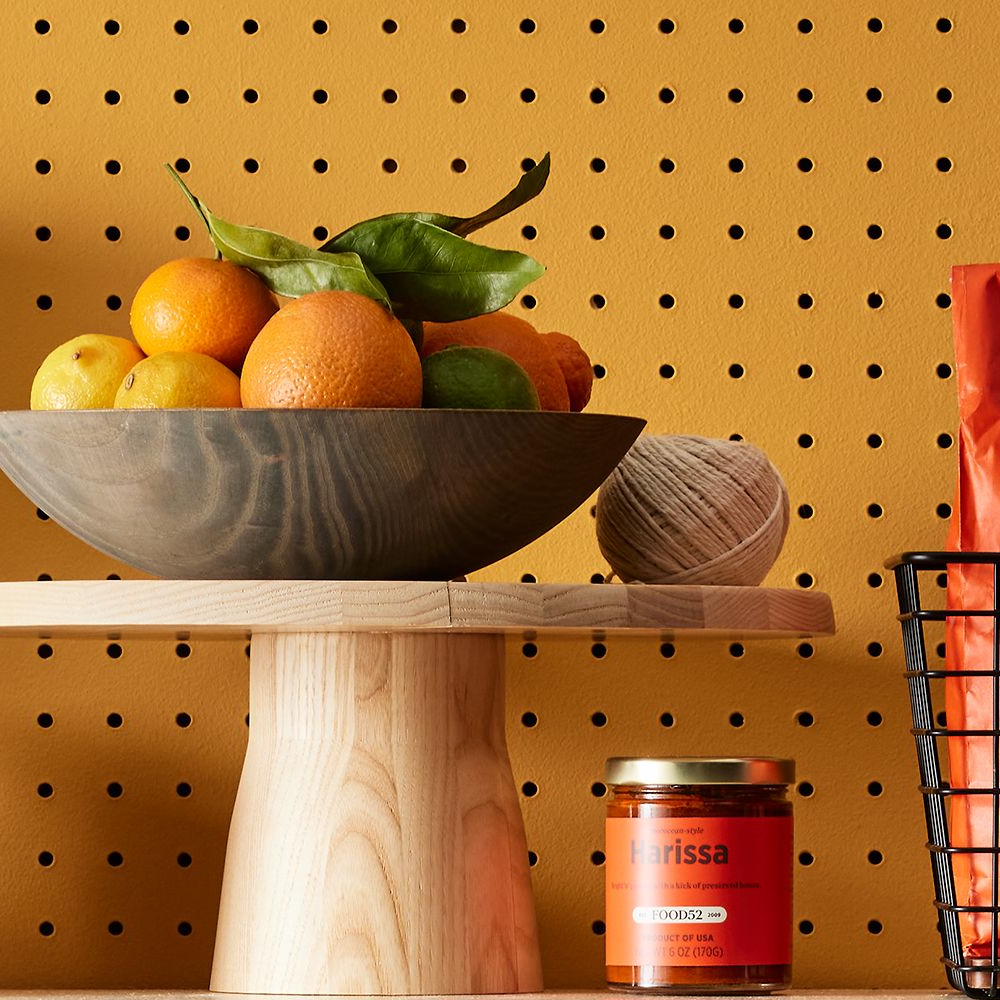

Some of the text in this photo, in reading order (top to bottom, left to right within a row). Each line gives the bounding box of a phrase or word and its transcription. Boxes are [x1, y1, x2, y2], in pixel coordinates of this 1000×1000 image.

[631, 838, 729, 865] Harissa
[652, 910, 703, 920] FOOD52
[696, 934, 714, 942] USA
[677, 947, 690, 957] OZ
[693, 946, 724, 958] (170G)
